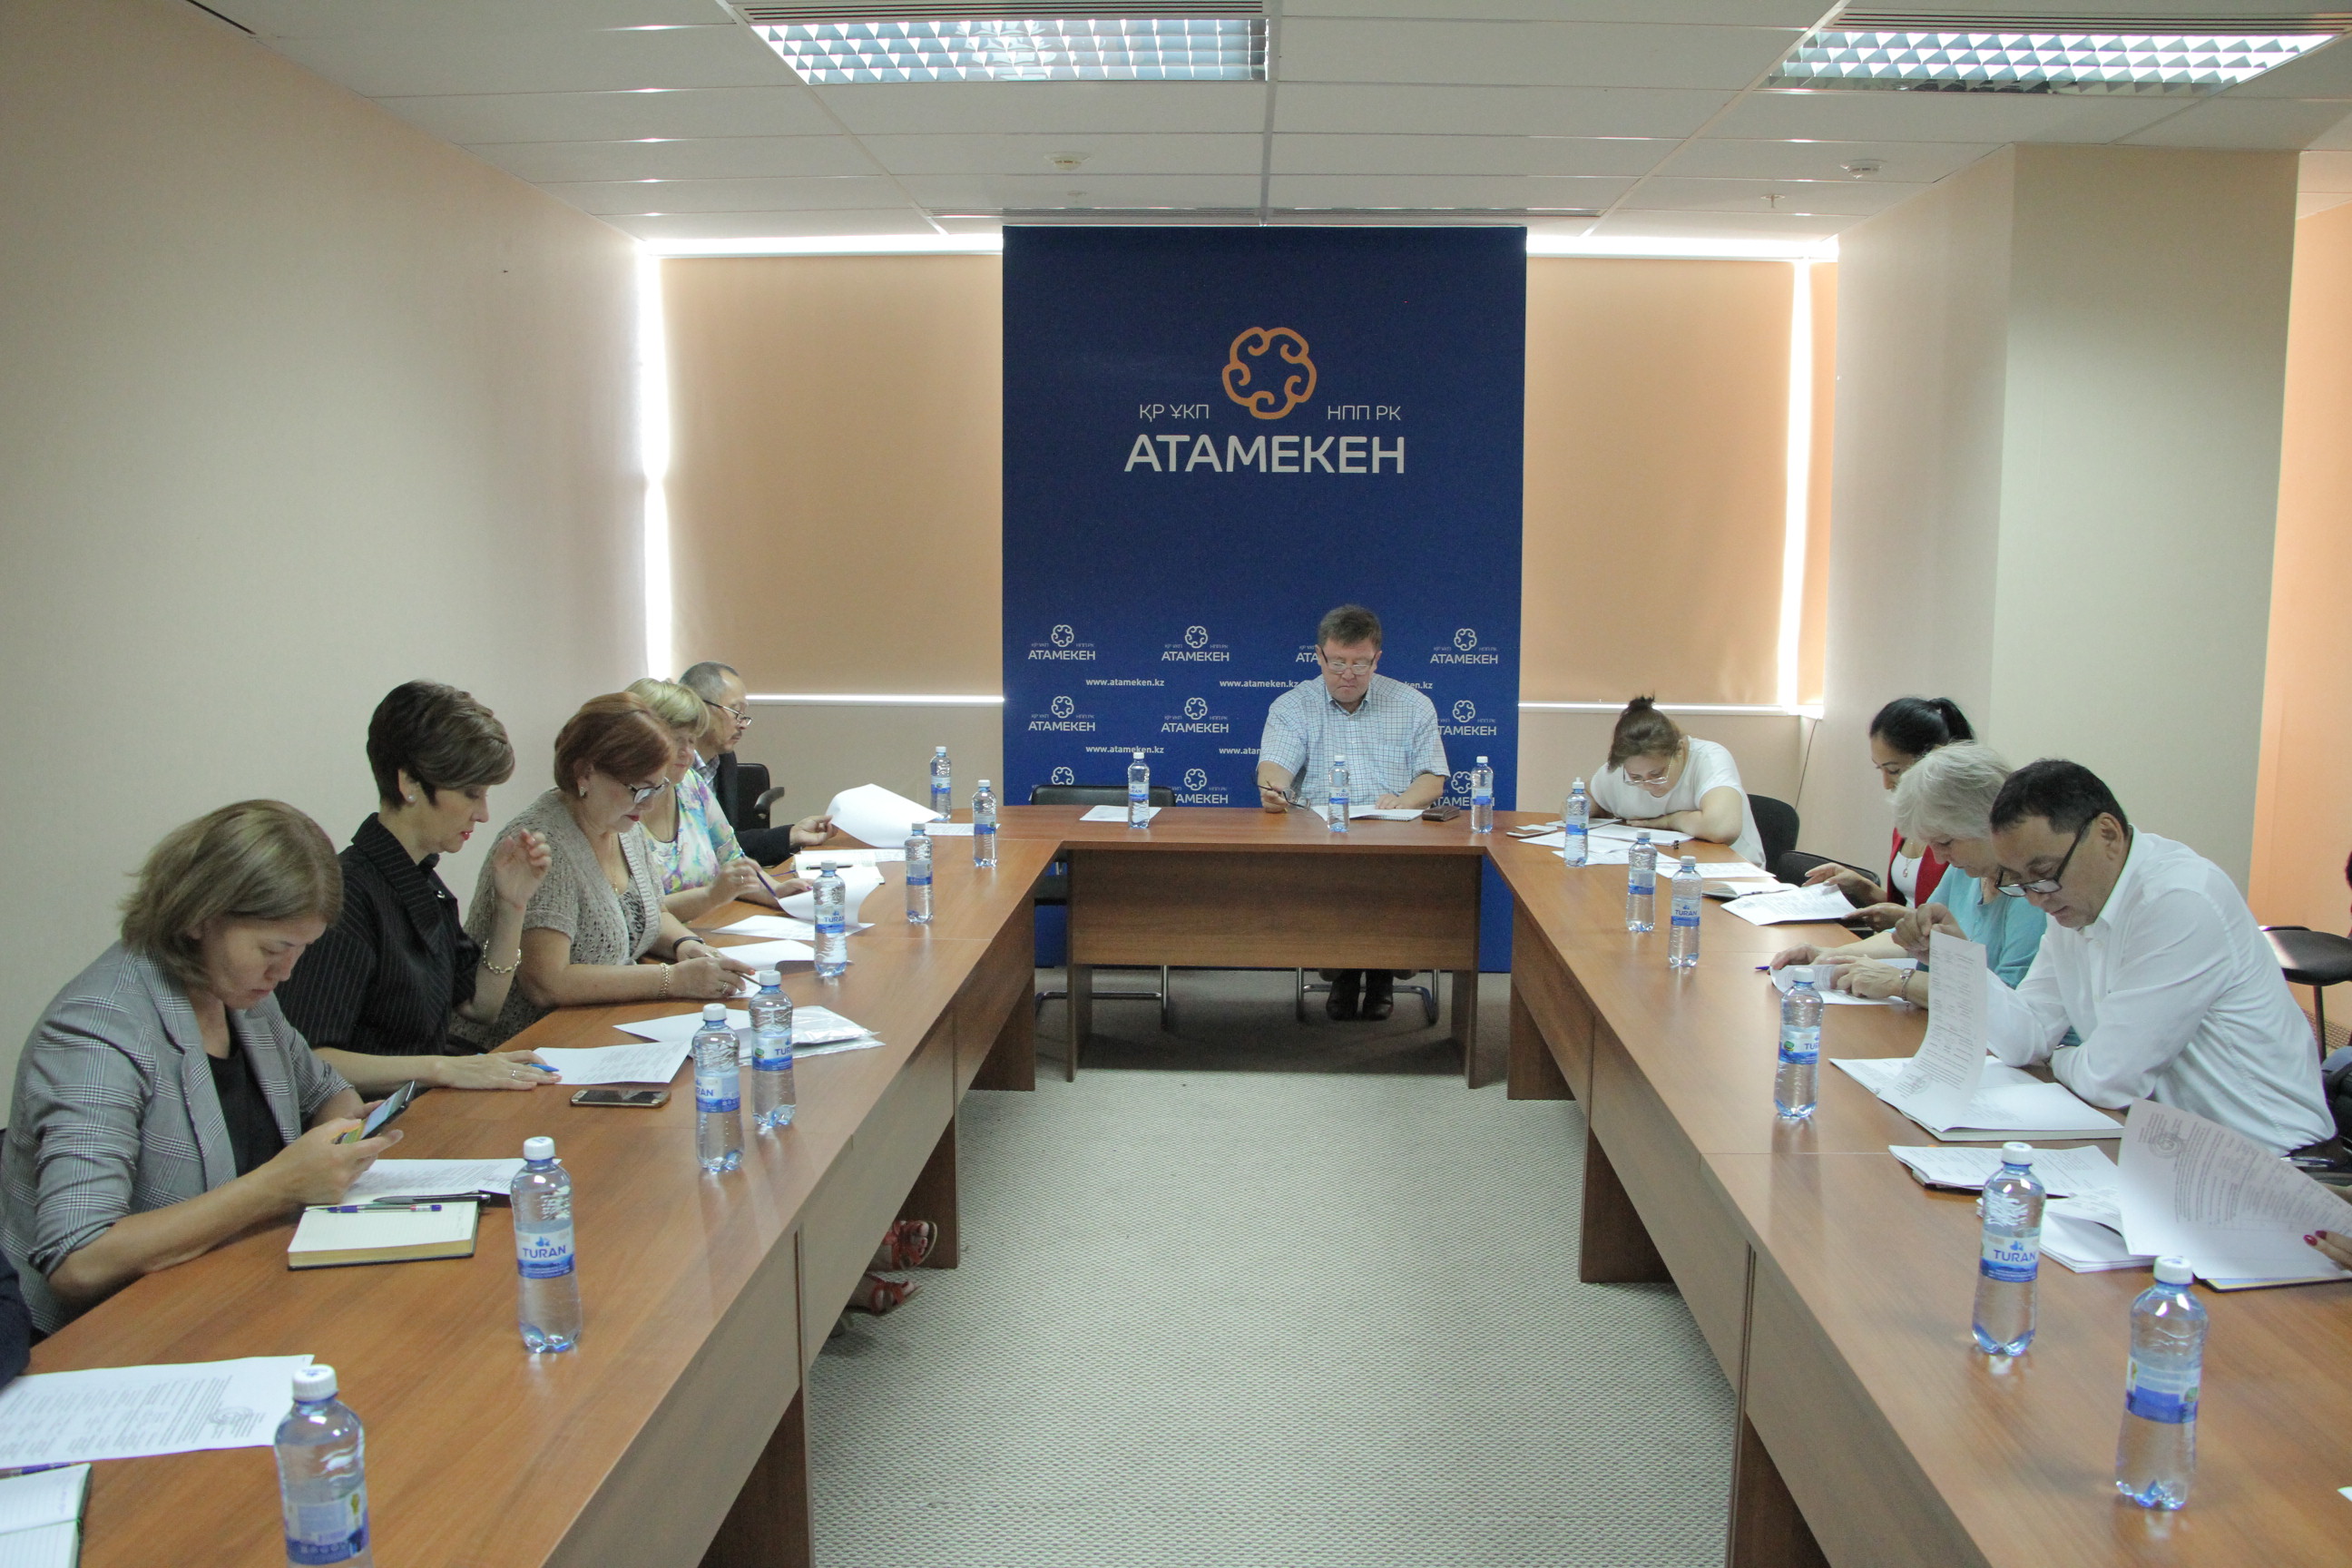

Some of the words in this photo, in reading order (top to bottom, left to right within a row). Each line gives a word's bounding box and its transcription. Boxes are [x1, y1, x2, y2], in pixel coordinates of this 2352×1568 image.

[1139, 404, 1165, 423] ҚР
[1328, 405, 1370, 420] НПП
[1376, 406, 1402, 421] РК
[1123, 434, 1405, 474] АТАМЕКЕН
[1027, 650, 1096, 661] АТАМЕКЕН
[1161, 651, 1230, 662] АТАМЕКЕН
[1429, 653, 1499, 664] АТАМЕКЕН
[1085, 678, 1165, 687] www.atameken.kz
[1027, 720, 1096, 732] АТАМЕКЕН
[1161, 722, 1230, 733] АТАМЕКЕН
[1437, 726, 1497, 736] ТАМЕКЕН
[1085, 745, 1165, 754] www.atameken.kz
[1174, 793, 1229, 804] АМЕКЕН
[522, 1244, 566, 1259] TURAN
[1993, 1249, 2036, 1262] TURAN
